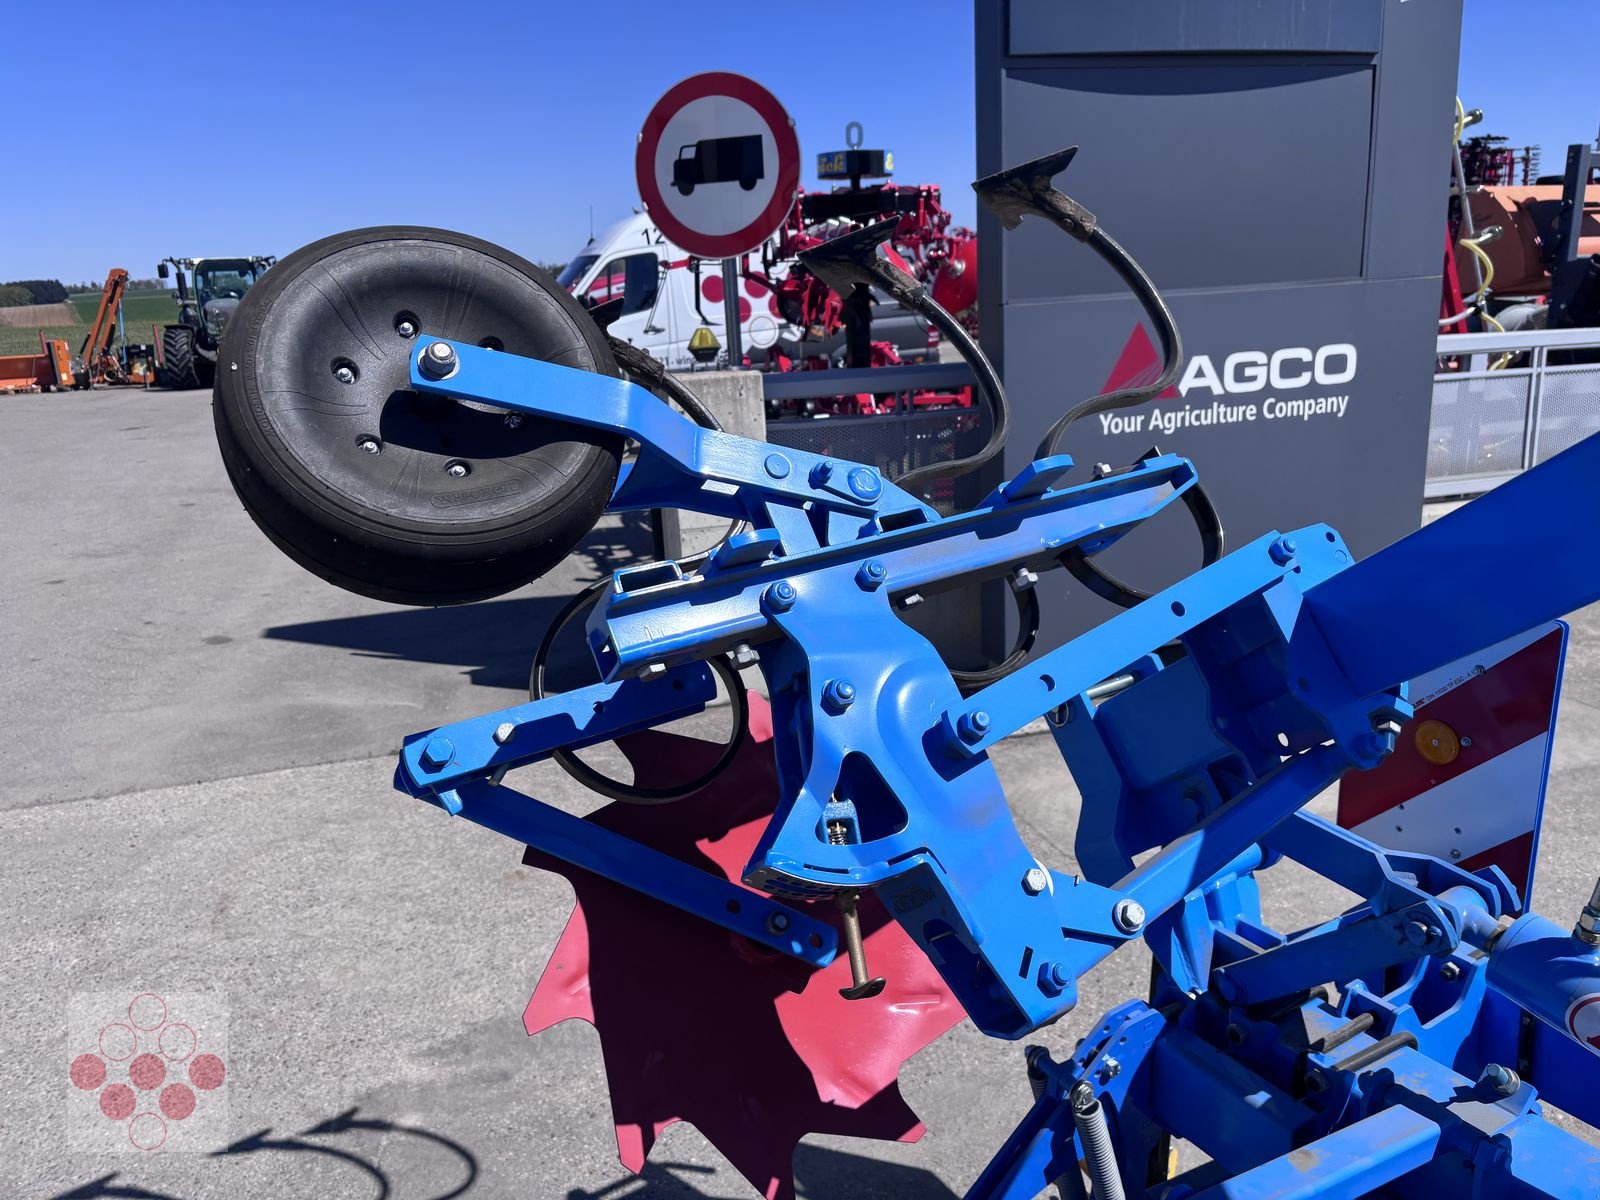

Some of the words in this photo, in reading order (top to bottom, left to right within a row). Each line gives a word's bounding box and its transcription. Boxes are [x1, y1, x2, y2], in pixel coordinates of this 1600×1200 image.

[1177, 342, 1358, 398] AGCO
[1099, 412, 1145, 435] Your
[1148, 401, 1257, 435] Agriculture
[1262, 394, 1349, 421] Company
